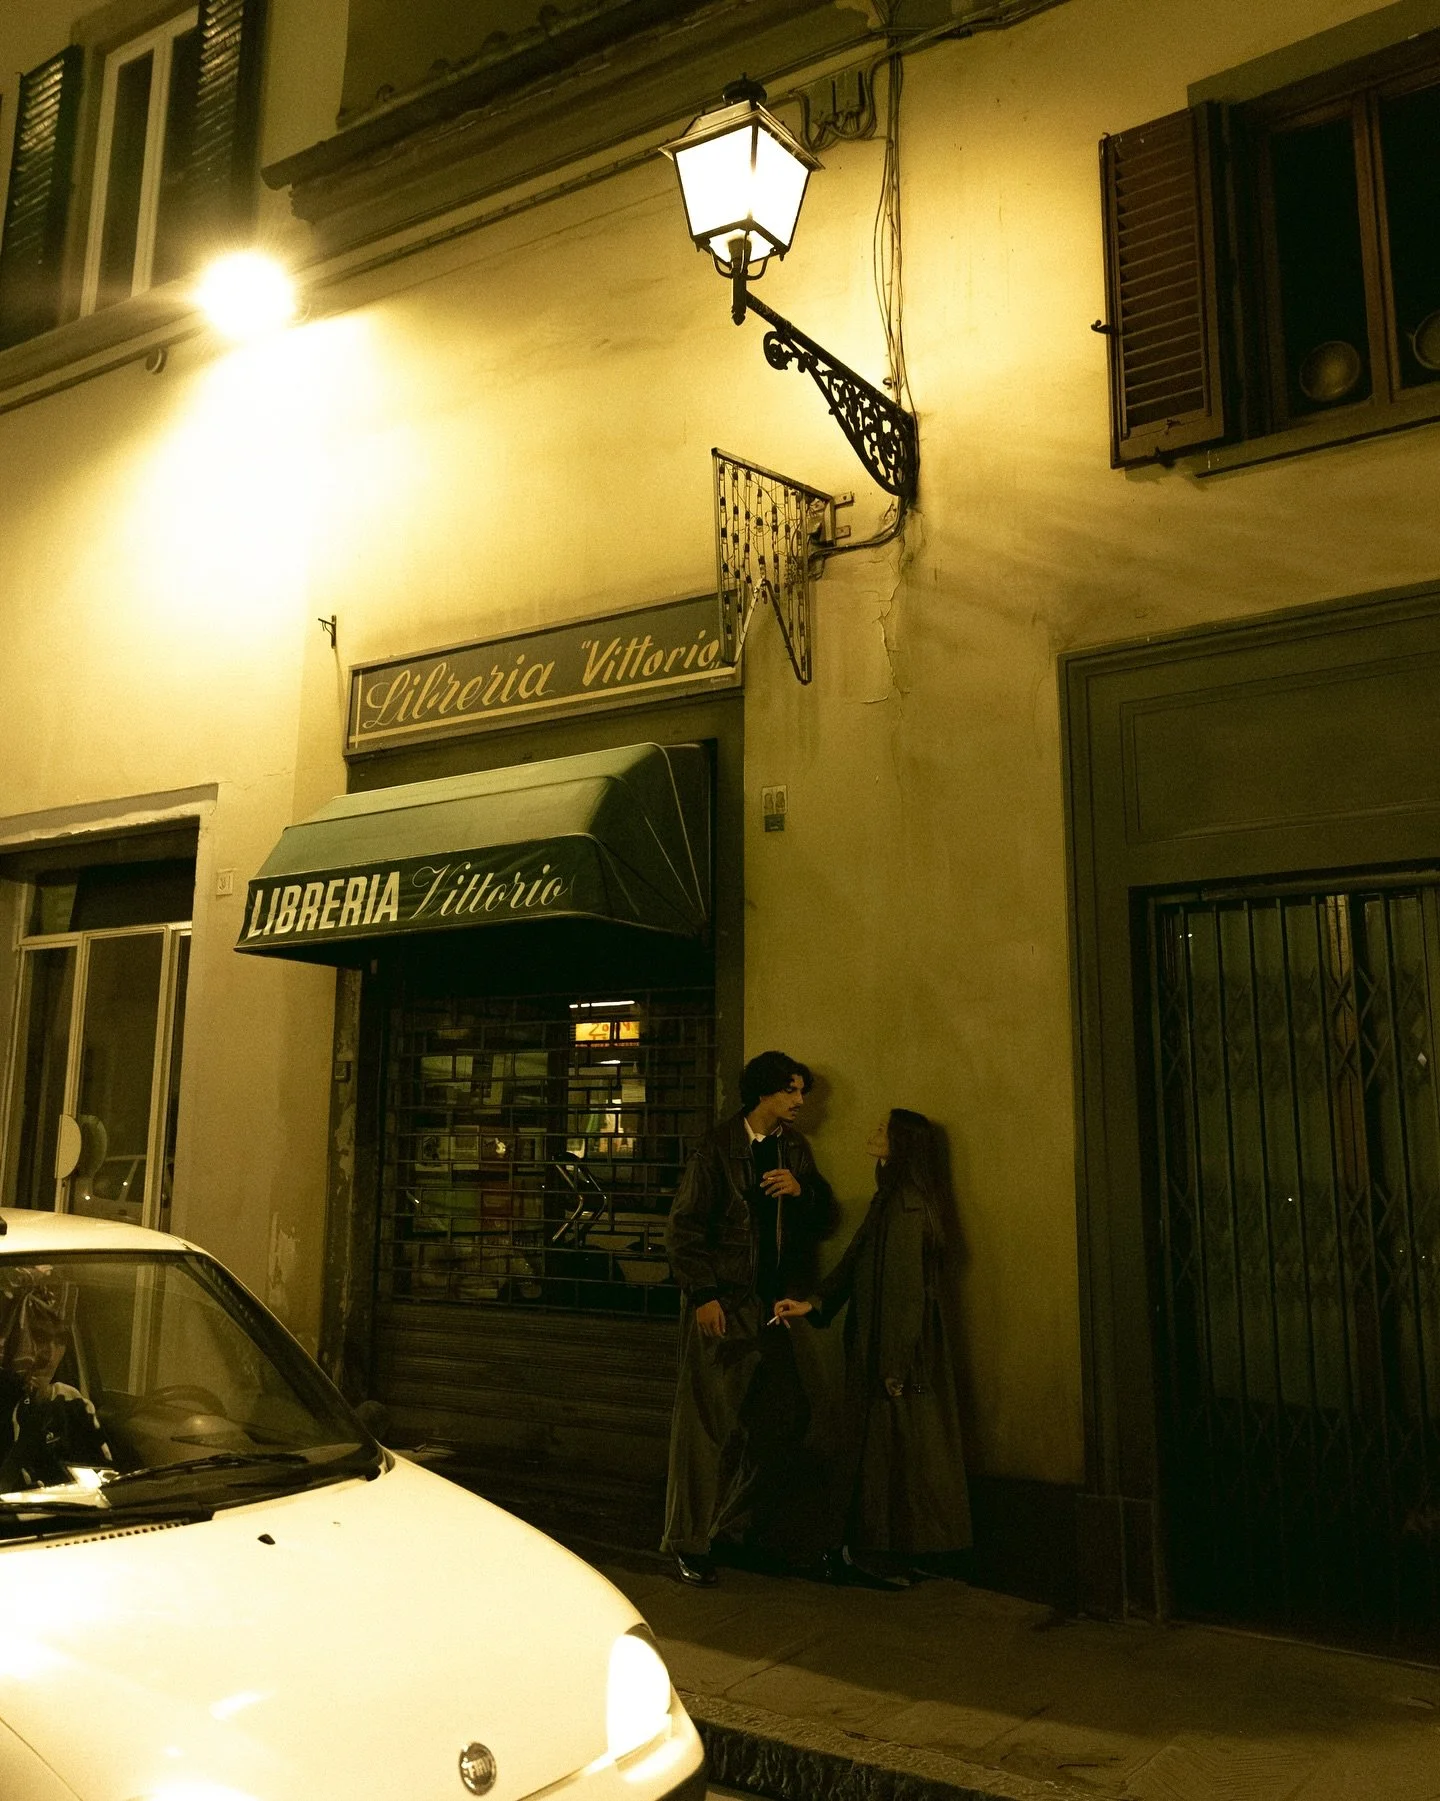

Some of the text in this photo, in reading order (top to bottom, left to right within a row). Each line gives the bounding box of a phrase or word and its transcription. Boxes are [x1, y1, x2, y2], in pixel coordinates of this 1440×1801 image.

[362, 654, 556, 729] Libreria
[247, 860, 568, 938] LIBRERIA Vittorio
